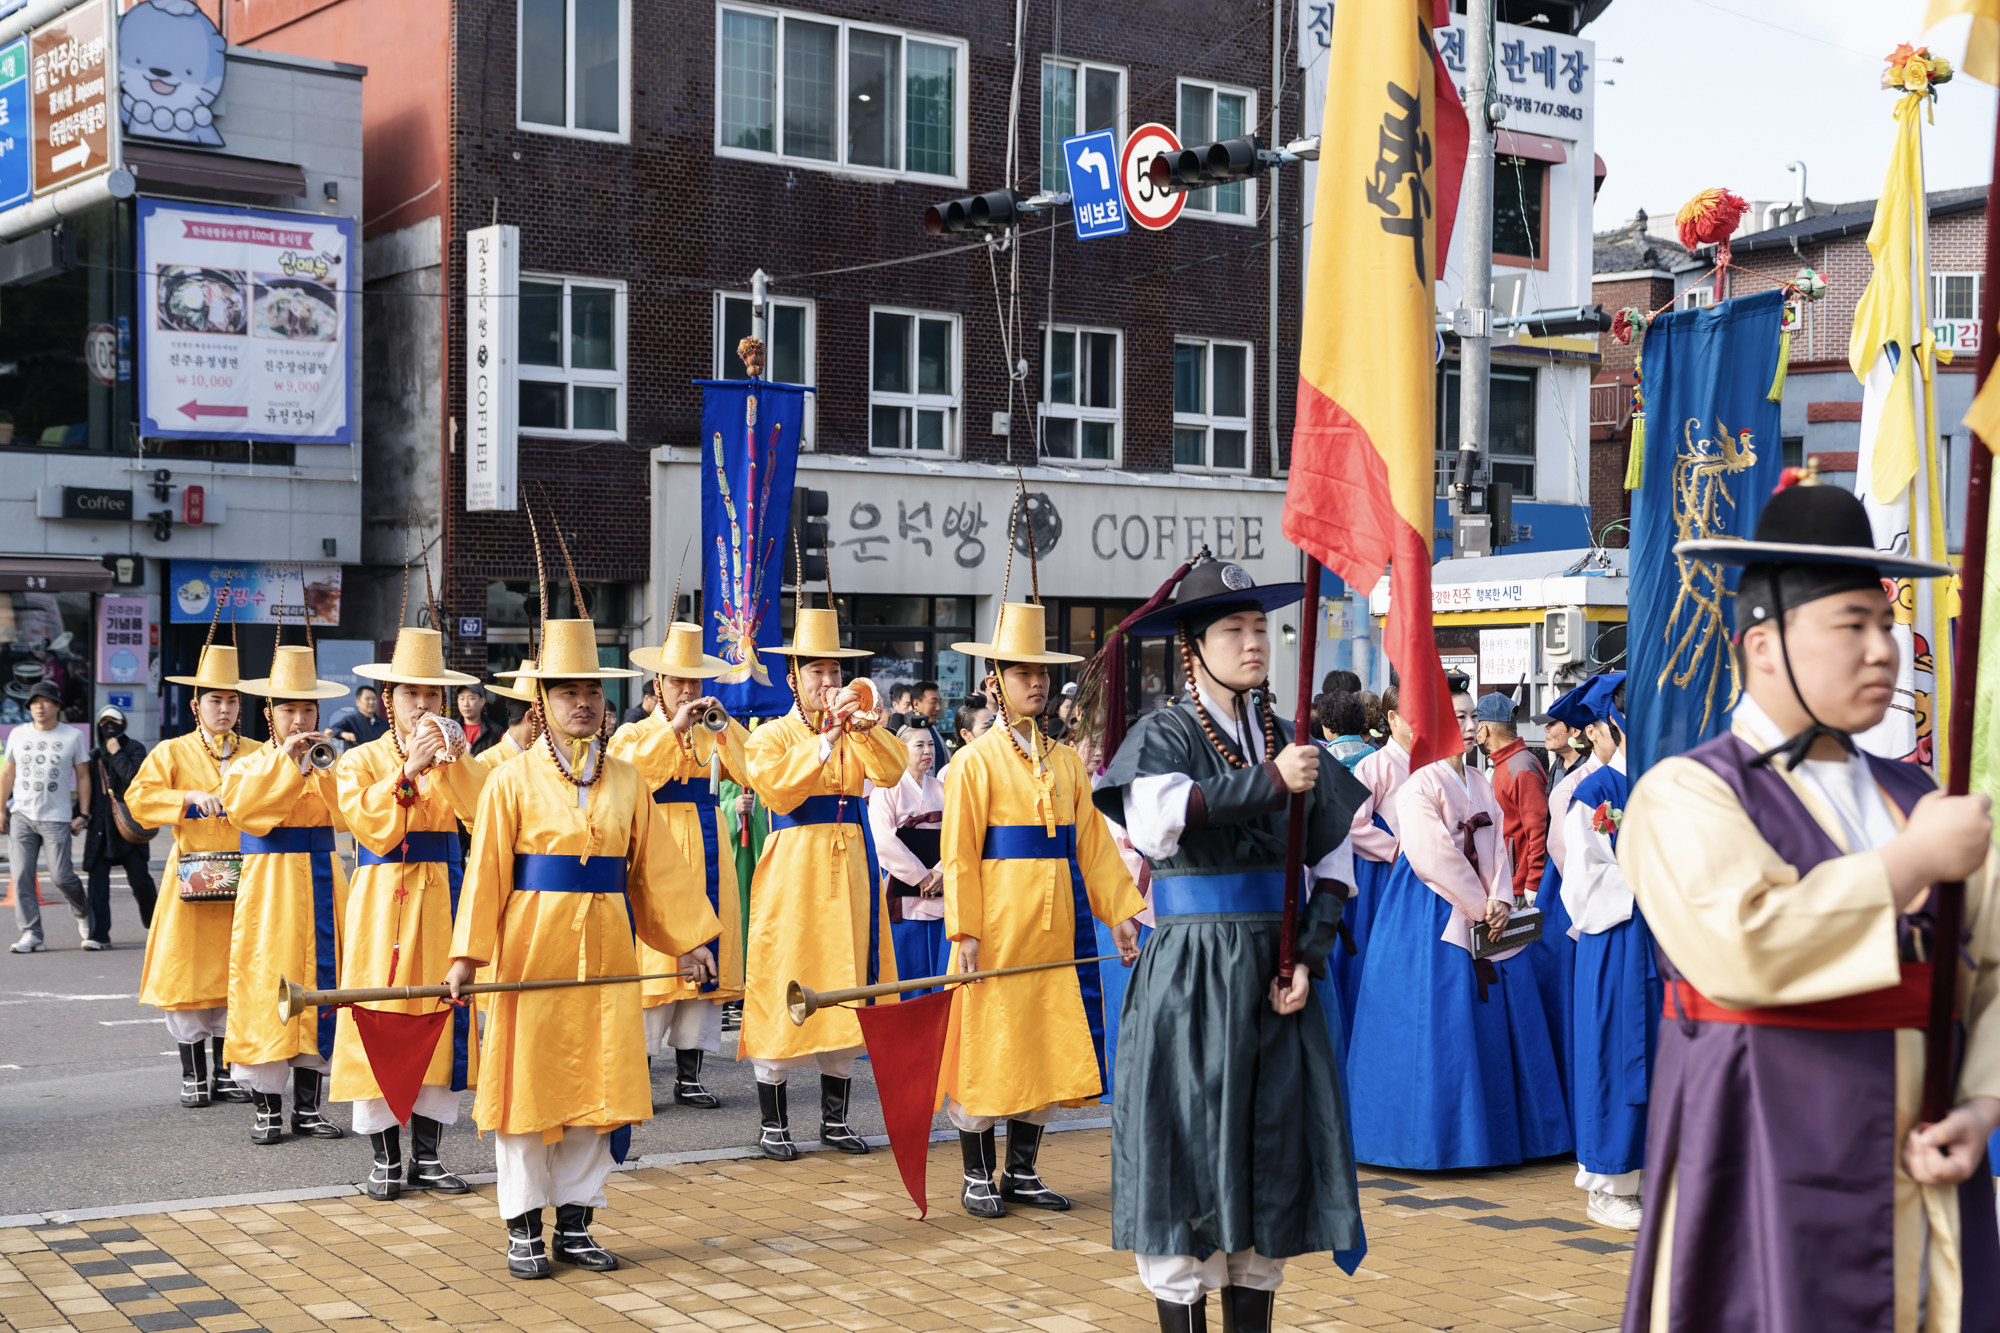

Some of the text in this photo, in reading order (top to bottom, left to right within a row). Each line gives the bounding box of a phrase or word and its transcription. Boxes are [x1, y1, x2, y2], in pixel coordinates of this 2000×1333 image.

[1500, 39, 1589, 93] 판매장
[1534, 100, 1583, 121] 747.9843
[1079, 198, 1121, 229] 비보호
[168, 353, 239, 370] 진주유정냉면
[477, 374, 488, 474] COFFEE
[77, 495, 125, 511] Coffee
[1092, 513, 1265, 561] COFFEE
[1452, 588, 1472, 604] 진주
[1476, 588, 1500, 602] 행복한
[1502, 585, 1522, 602] 시민
[107, 617, 143, 631] 기념품
[107, 632, 143, 646] 판매점
